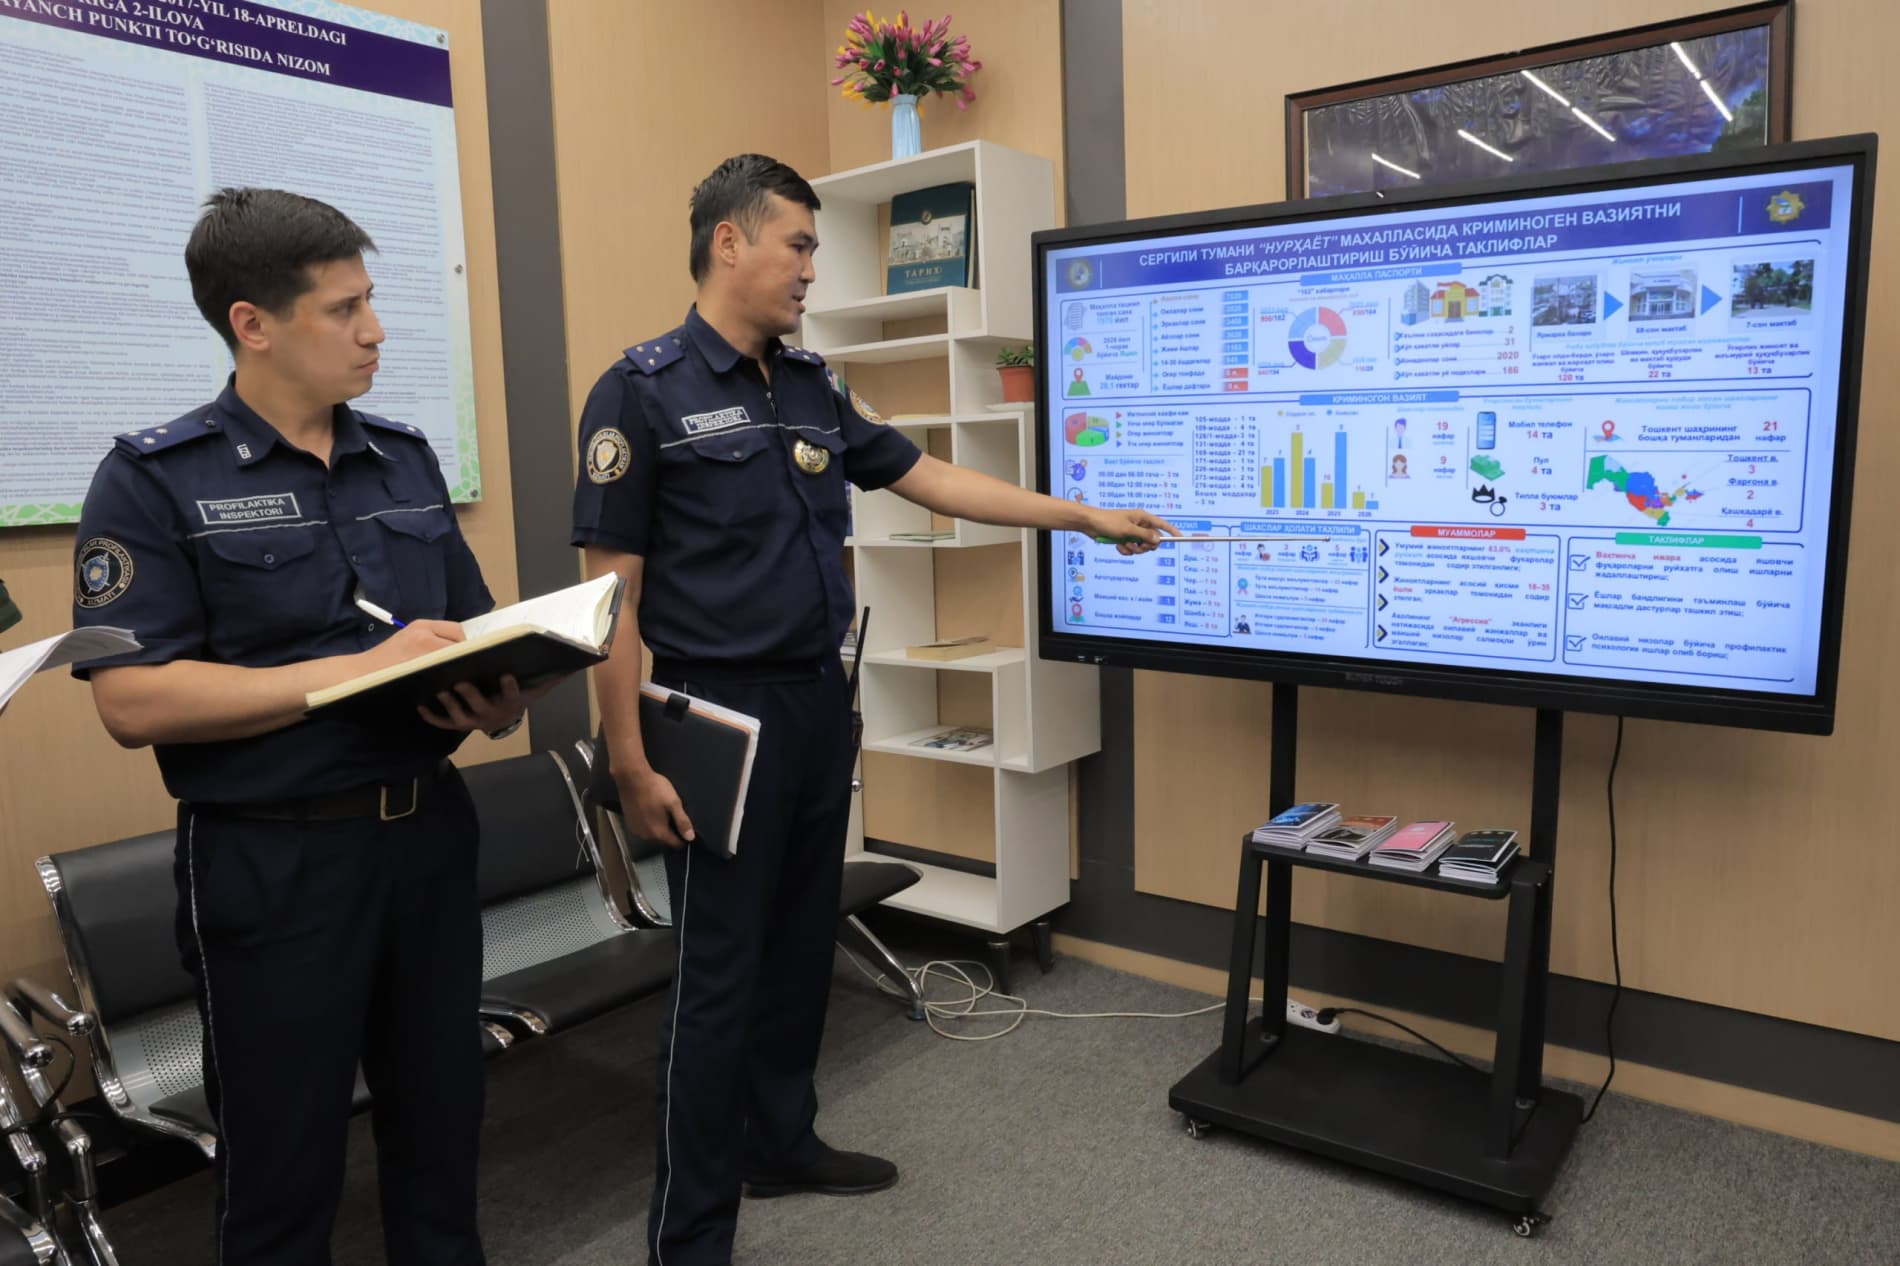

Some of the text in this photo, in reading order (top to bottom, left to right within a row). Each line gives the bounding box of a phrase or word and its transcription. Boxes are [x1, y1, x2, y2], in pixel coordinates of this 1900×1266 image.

[132, 2, 205, 31] 2-ILOVA
[159, 0, 347, 46] 17-YIL 18-APRELDAGI
[88, 11, 161, 40] PUNKTI
[277, 53, 330, 76] NIZOM
[1139, 250, 1197, 267] СЕРГИЛИ
[1200, 244, 1255, 260] ТУМАНИ
[1462, 212, 1577, 237] КРИМИНОГЕН
[1581, 202, 1681, 226] ВАЗИЯТНИ
[1225, 251, 1384, 276] БАРҚАРОРЛАШТИРИШ
[1456, 234, 1558, 256] ТАКЛИФЛАР
[1496, 351, 1520, 360] 2020
[1648, 370, 1659, 378] 22
[1437, 421, 1449, 431] 19
[1508, 421, 1573, 429] Мобил телефон
[1642, 425, 1682, 433] Тошкент
[1763, 421, 1778, 432] 21
[1527, 430, 1553, 440] 14 та
[1671, 434, 1741, 444] туманларидан
[1755, 435, 1787, 443] нафар
[1440, 456, 1447, 465] 9
[1533, 456, 1549, 465] Пул
[1728, 454, 1768, 463] Тошкент
[1531, 466, 1552, 476] 4 та
[1748, 464, 1756, 474] 3
[1746, 490, 1755, 500] 2
[209, 498, 286, 512] PROFILAKTIKA
[1539, 502, 1561, 511] 3 та
[219, 507, 283, 520] INSPEKTORI
[1746, 519, 1755, 528] 4
[1437, 528, 1497, 538] МУАММОЛАР
[1649, 535, 1705, 545] ТАКЛИФЛАР
[1699, 556, 1737, 564] асосида
[1713, 566, 1739, 574] олиш
[1749, 568, 1793, 577] ишларни
[1636, 603, 1681, 614] дастурлар
[1684, 606, 1716, 616] ташкил
[1591, 633, 1630, 643] Оилавий
[1725, 641, 1788, 654] профилактик
[1672, 648, 1695, 657] олиб
